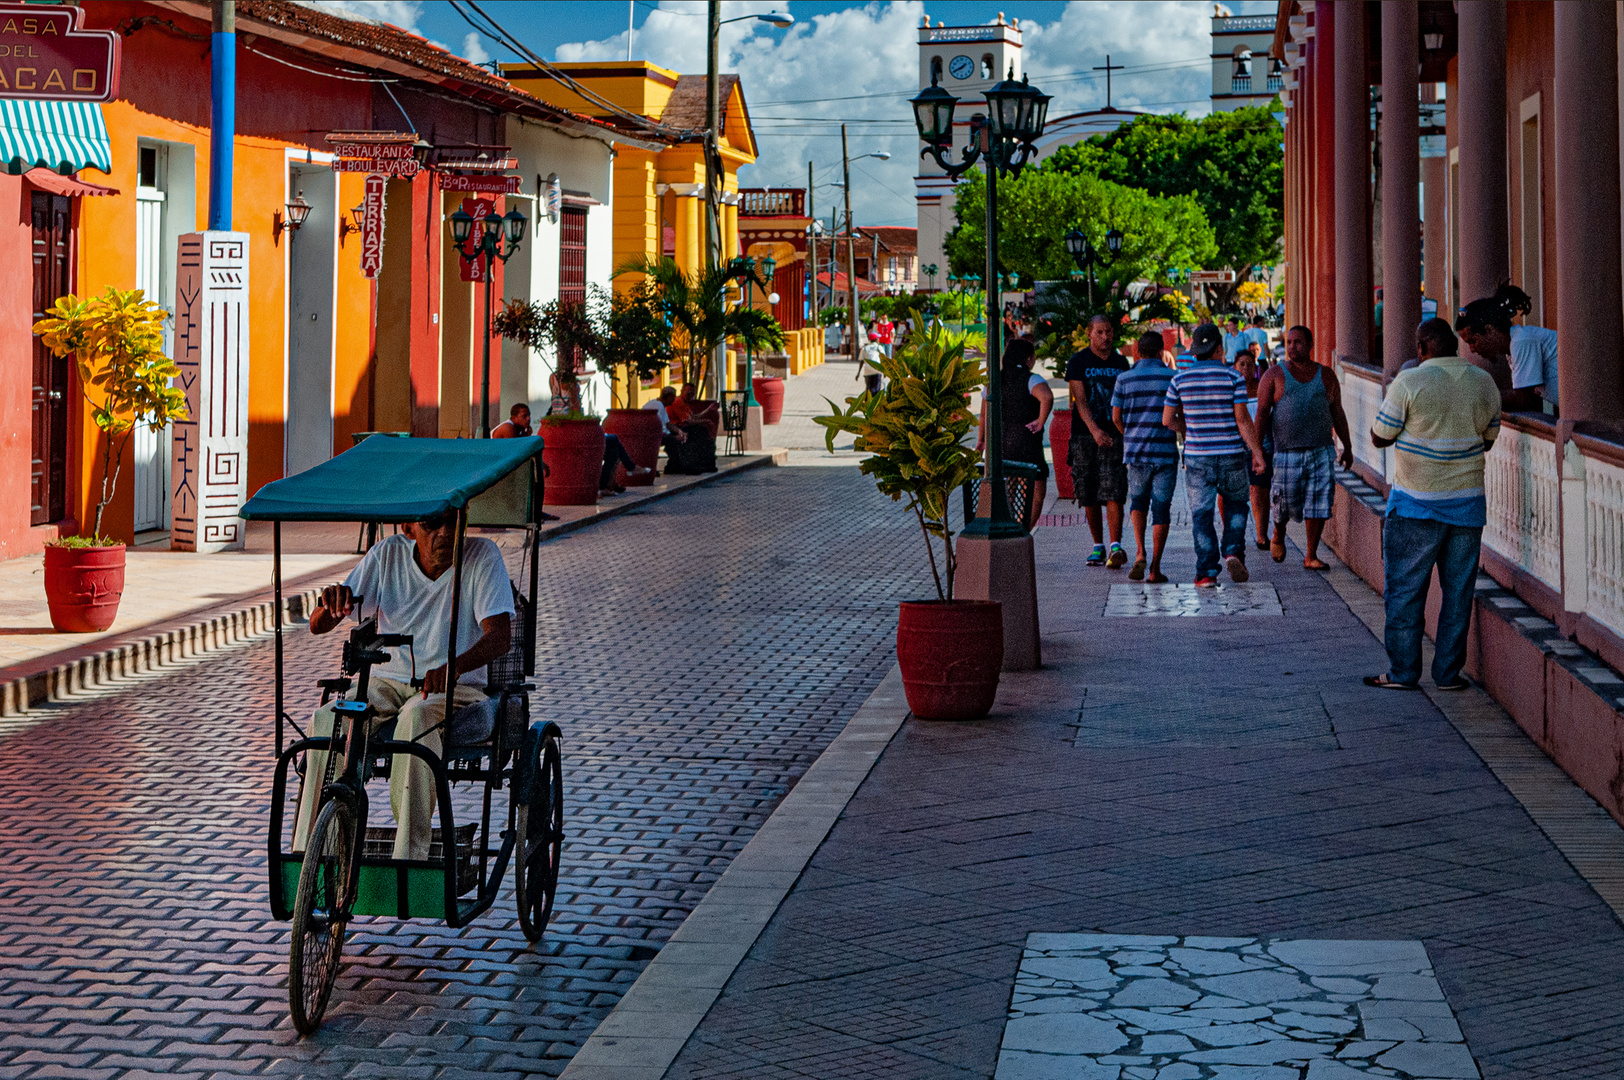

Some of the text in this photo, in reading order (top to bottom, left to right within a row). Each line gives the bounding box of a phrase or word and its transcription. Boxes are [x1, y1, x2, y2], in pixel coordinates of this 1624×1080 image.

[0, 44, 39, 58] DEL
[333, 160, 417, 173] EL BOULEVARD
[364, 179, 383, 269] TERRAZA
